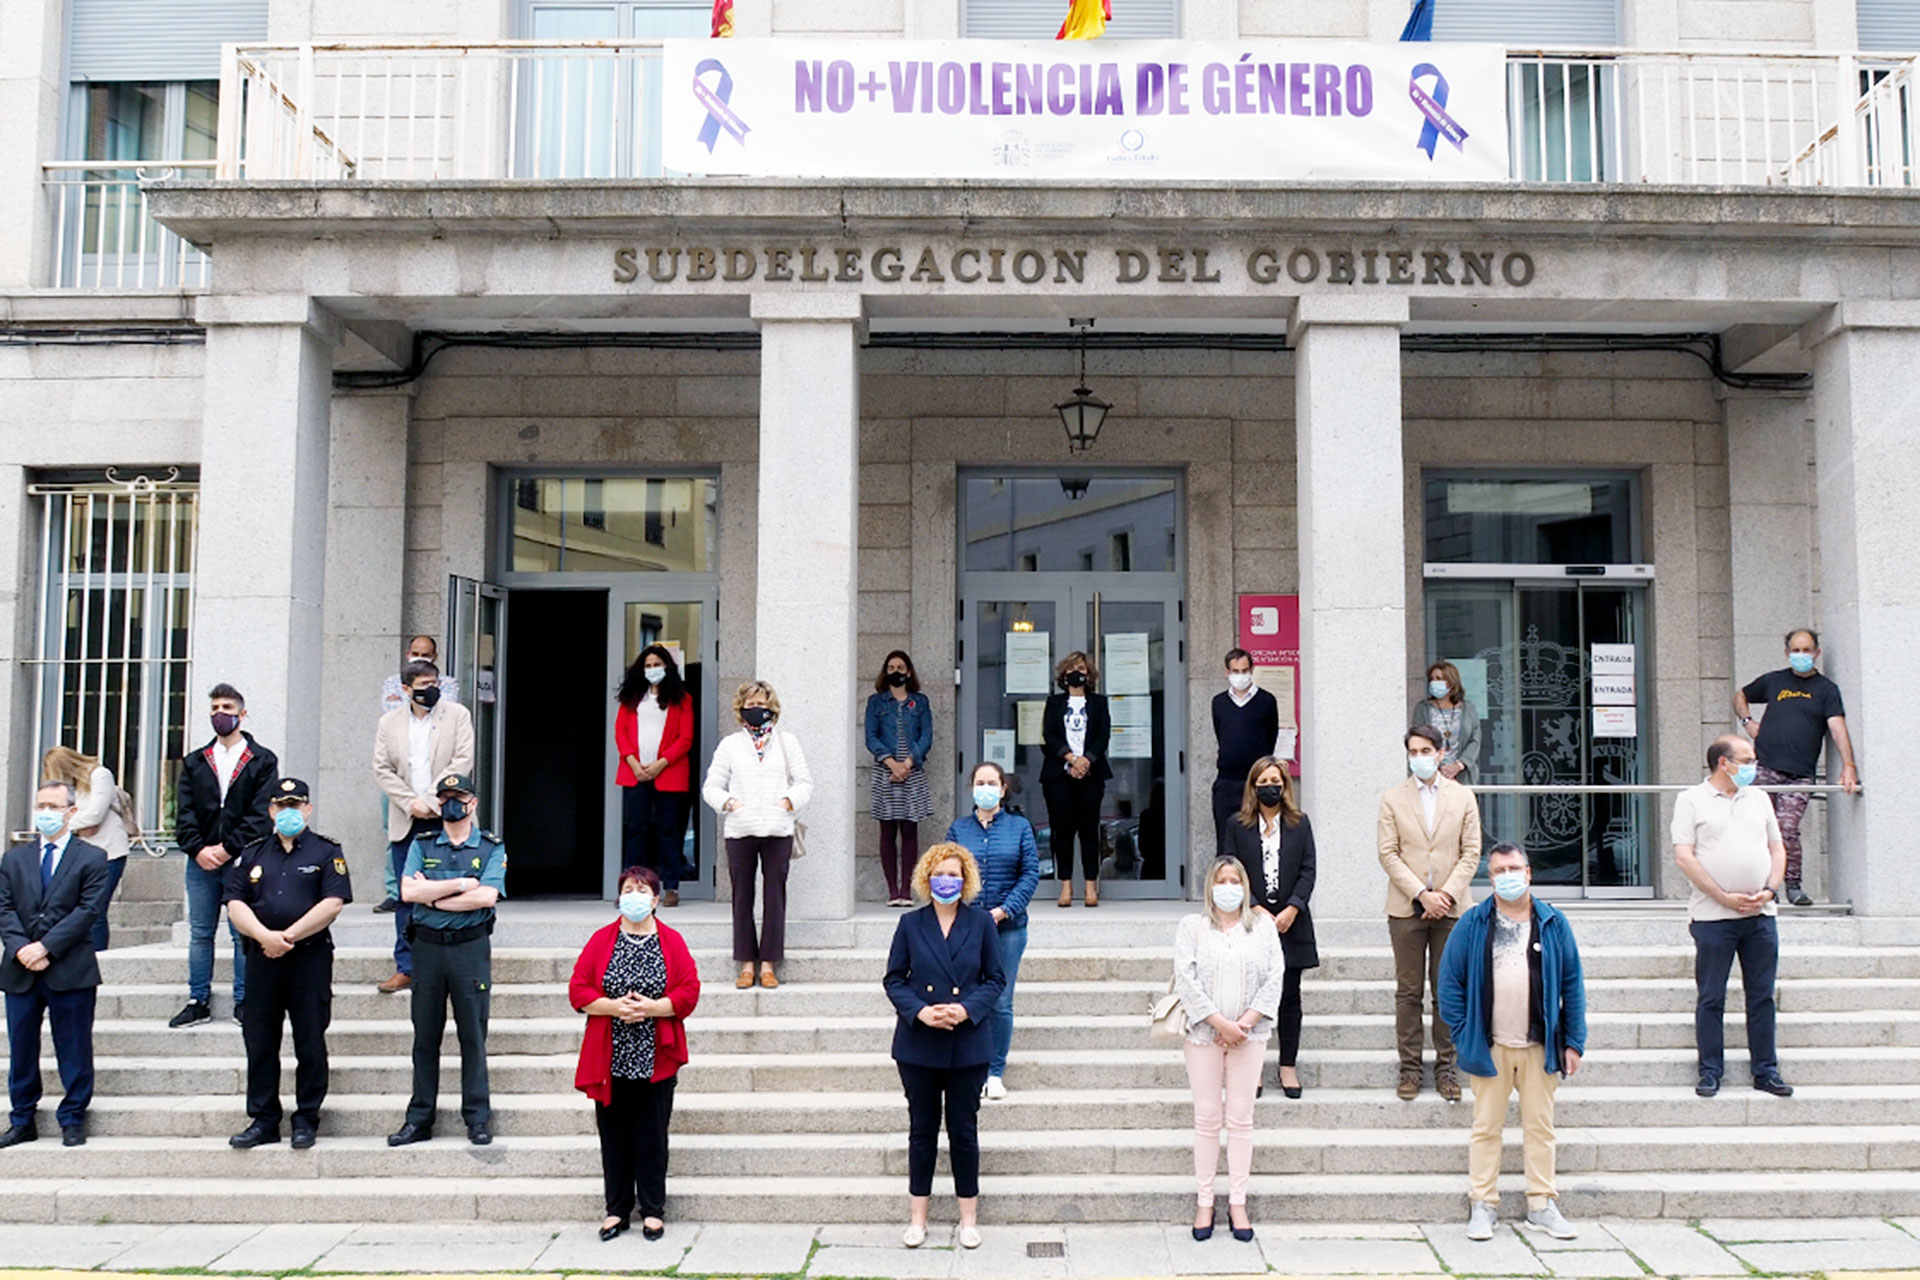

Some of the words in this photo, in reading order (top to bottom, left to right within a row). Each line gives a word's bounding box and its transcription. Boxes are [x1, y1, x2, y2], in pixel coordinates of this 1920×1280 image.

[795, 60, 1124, 116] NO+VIOLENCIA
[1136, 63, 1190, 116] DE
[1202, 52, 1373, 118] GÉNERO
[613, 246, 1087, 283] SUBDELEGACION
[1115, 249, 1221, 284] DEL
[1246, 249, 1535, 286] GOBIERNO
[1593, 654, 1632, 663] ENTRADA
[1594, 685, 1633, 694] ENTRADA
